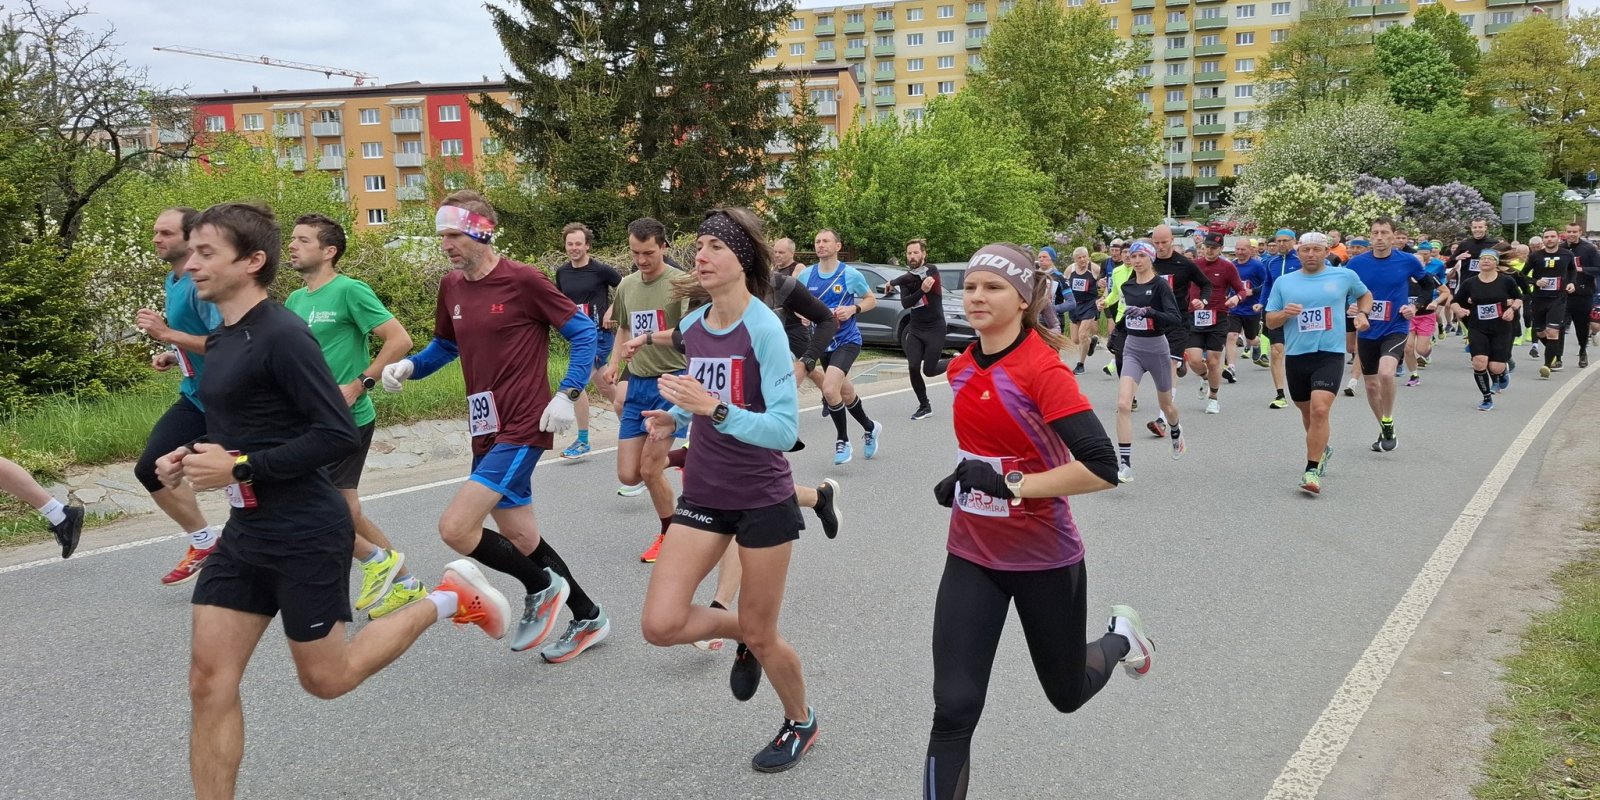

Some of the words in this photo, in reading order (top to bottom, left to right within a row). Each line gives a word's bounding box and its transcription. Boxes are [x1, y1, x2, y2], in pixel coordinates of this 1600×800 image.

[1197, 311, 1211, 320] 425
[1301, 309, 1322, 323] 378
[1480, 305, 1495, 315] 396
[635, 313, 654, 330] 387
[694, 362, 726, 390] 416
[472, 396, 490, 420] 299
